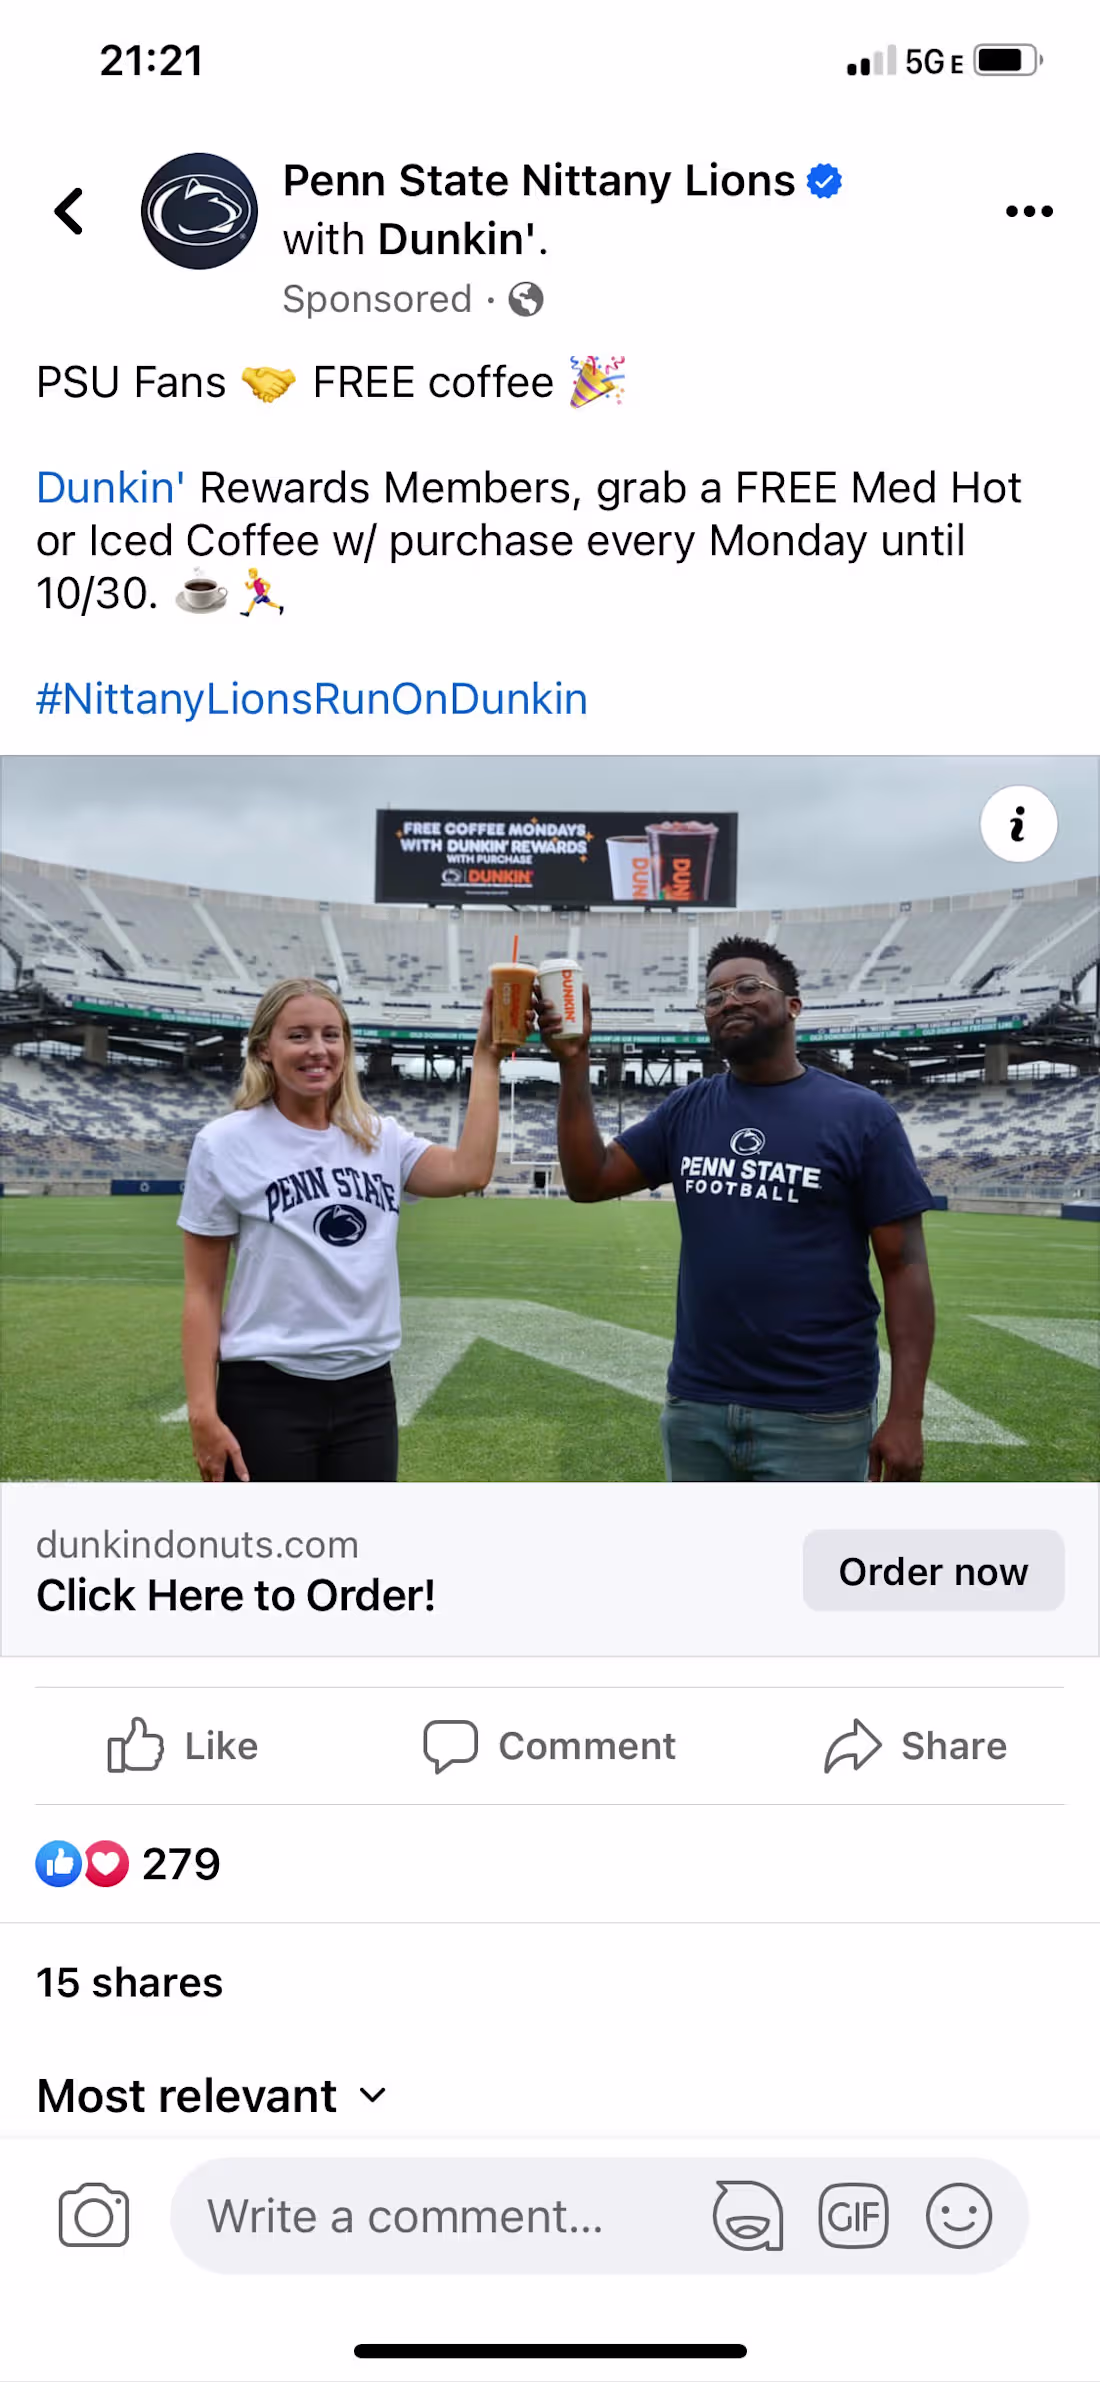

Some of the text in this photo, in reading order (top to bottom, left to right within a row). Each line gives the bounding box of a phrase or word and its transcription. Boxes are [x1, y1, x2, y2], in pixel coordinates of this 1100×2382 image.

[100, 44, 203, 77] 21:21
[284, 161, 796, 205] Penn State Nittany Lions
[282, 220, 548, 256] with Dunkin'.
[283, 283, 471, 320] Sponsored
[38, 364, 554, 399] PSU Fans FREE coffee
[38, 470, 1022, 512] Dunkin' Rewards Members, grab a FREE Med Hot
[36, 522, 964, 565] or Iced Coffee w/ purchase every Monday until
[37, 576, 157, 617] 10/30.
[36, 680, 587, 723] #NittanyLionsRunOnDunkin
[400, 838, 587, 855] WITH DUNKIN' REWARDS
[403, 822, 587, 838] FREE COFFEE MONDAYS
[446, 855, 533, 865] WITH PURCHASE
[681, 1156, 822, 1189] PENN STATE
[265, 1167, 400, 1223] PENN STATE
[685, 1179, 800, 1204] FOOTBALL
[36, 1528, 359, 1560] dunkindonuts.com
[839, 1556, 1030, 1587] Order now
[36, 1576, 436, 1613] Click Here to Order!
[186, 1730, 258, 1761] Like
[499, 1731, 677, 1761] Comment
[902, 1731, 1007, 1761] Share
[143, 1847, 221, 1881] 279
[36, 1966, 223, 1999] 15 shares
[38, 2077, 337, 2114] Most relevant
[207, 2197, 602, 2234] Write a comment...
[828, 2201, 879, 2232] GIF
